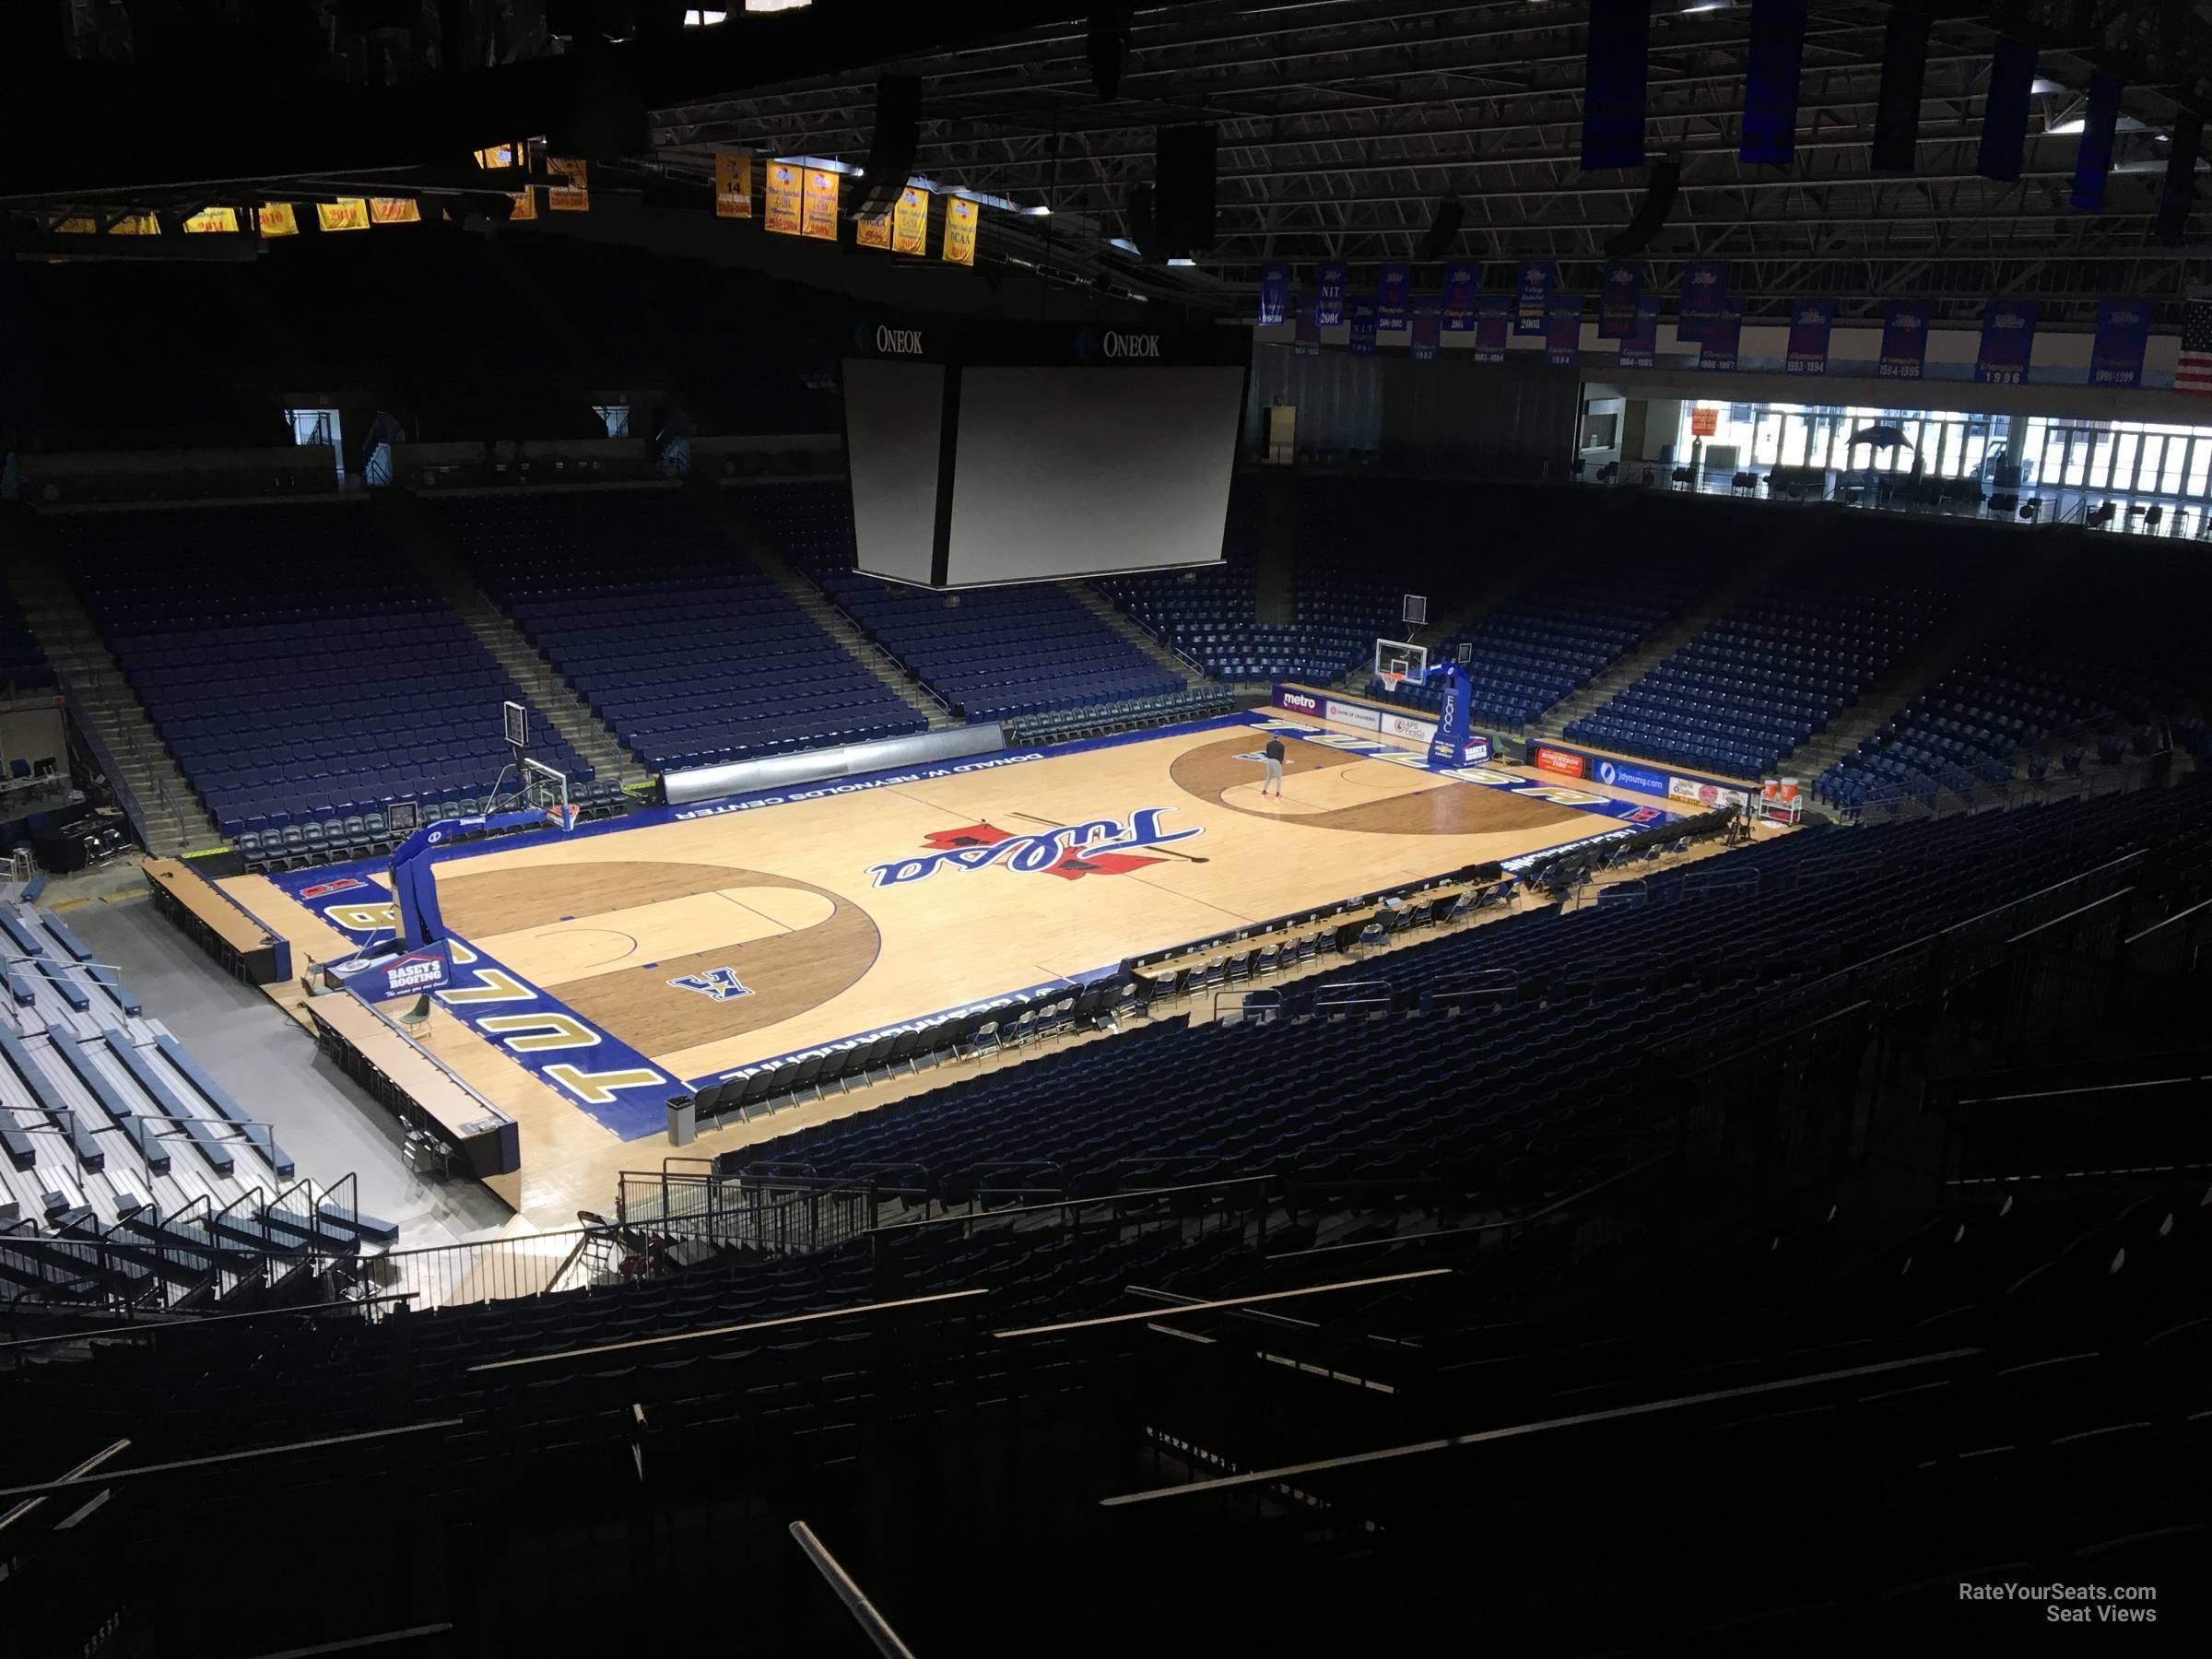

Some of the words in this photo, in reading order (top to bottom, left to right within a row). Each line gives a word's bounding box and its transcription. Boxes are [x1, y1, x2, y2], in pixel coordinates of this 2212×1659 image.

[1322, 286, 1340, 298] NIT
[877, 325, 924, 355] ONEOK
[1103, 330, 1161, 358] ONEOK
[1985, 371, 2020, 383] 1996
[1284, 693, 1316, 709] metro
[1406, 721, 1418, 730] APS
[952, 752, 1045, 772] DONALD
[788, 773, 919, 801] REYNOLDS
[675, 796, 783, 821] CENTER
[387, 960, 441, 981] BASEY'S
[389, 971, 441, 989] ROOFING
